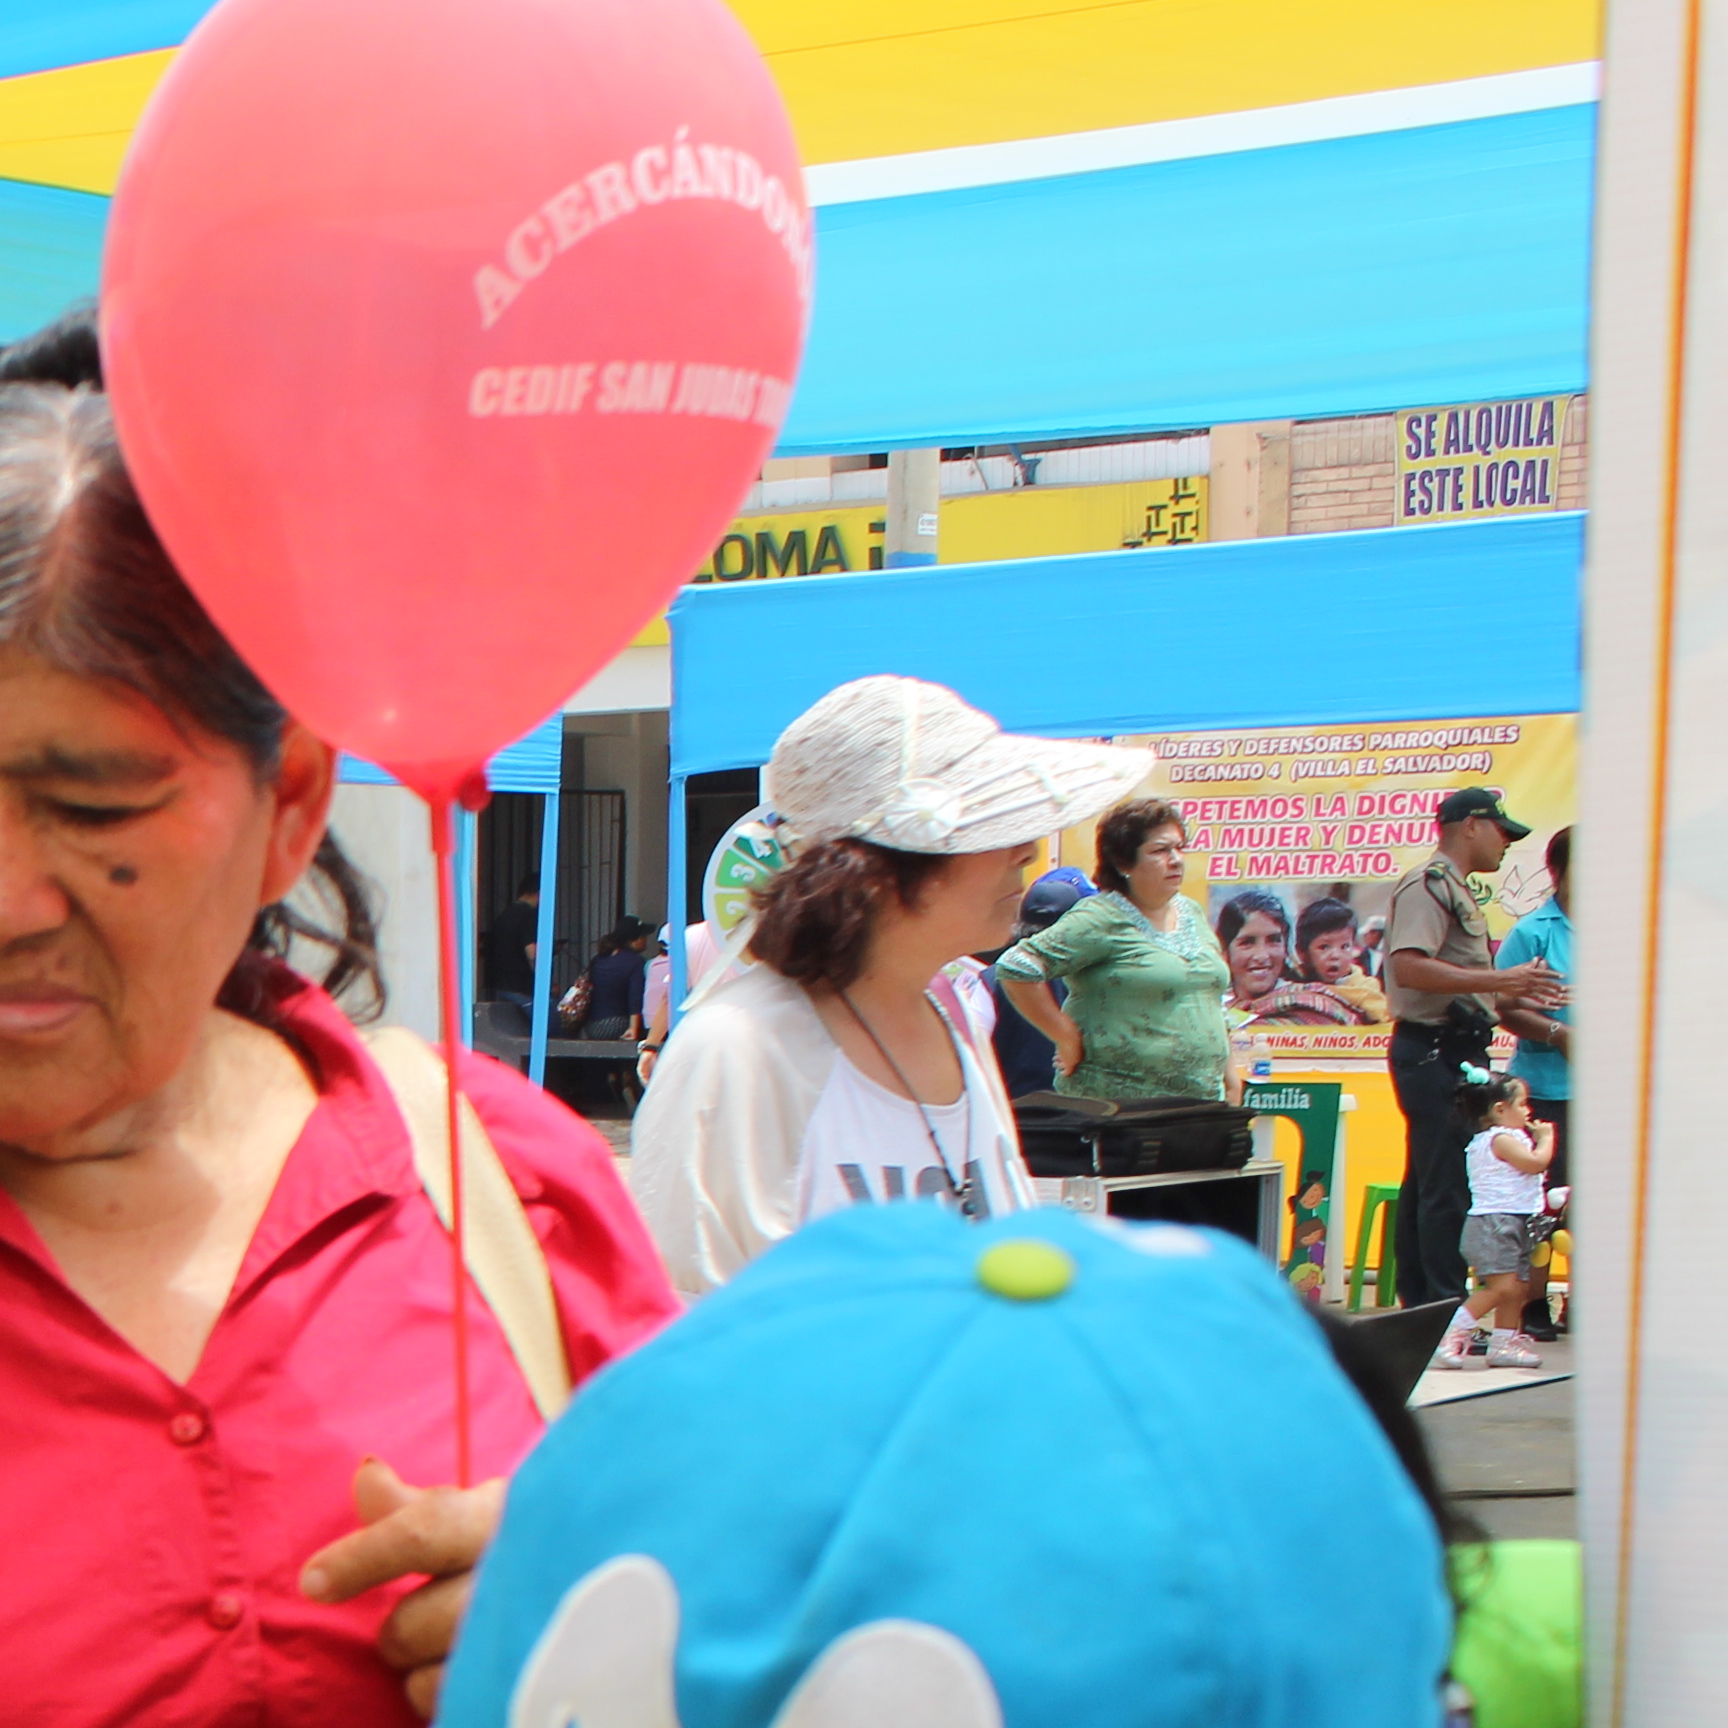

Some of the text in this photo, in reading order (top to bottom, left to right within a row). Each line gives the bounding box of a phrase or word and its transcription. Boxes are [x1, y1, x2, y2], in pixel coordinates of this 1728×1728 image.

[469, 363, 596, 418] CEDIF
[595, 360, 676, 414] SAN
[1405, 401, 1554, 461] SE ALQUILA
[1403, 459, 1551, 517] ESTE LOCAL
[1226, 739, 1243, 757] Y
[1244, 733, 1365, 756] DEFENSORES
[1368, 725, 1520, 751] PARROQUIALES
[1170, 751, 1493, 783] DECANATO 4 (VILLA EL SALVADOR)
[1310, 792, 1348, 821] LA
[749, 838, 772, 859] 4
[1219, 822, 1313, 851] MUJER
[1319, 822, 1339, 850] Y
[730, 862, 756, 883] 3
[1206, 850, 1401, 881] EL MALTRATO.
[1312, 1032, 1359, 1051] NIÑOS,
[1243, 1088, 1311, 1110] familia
